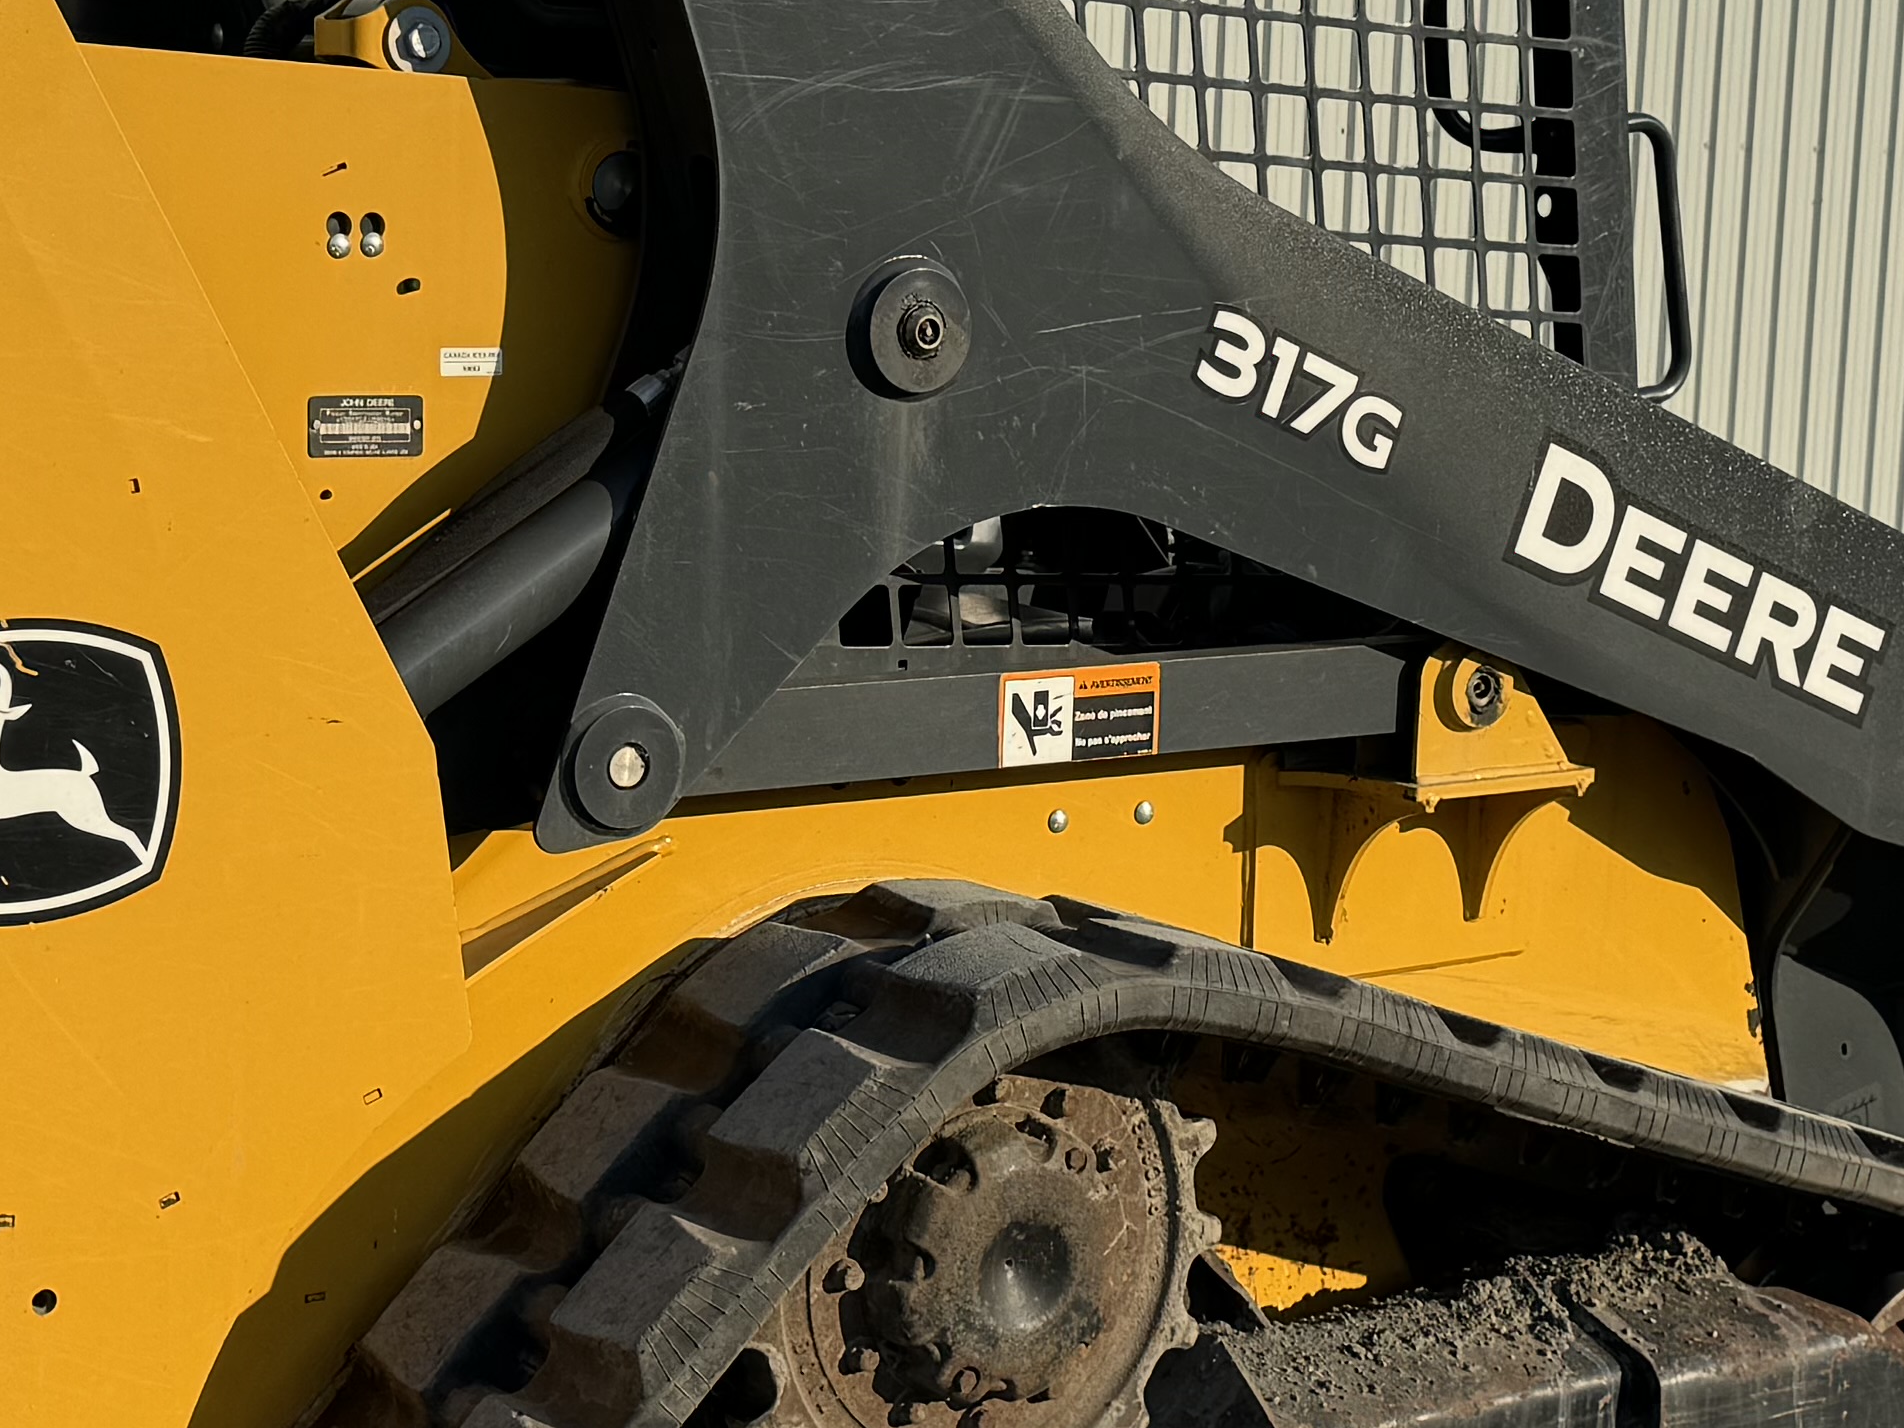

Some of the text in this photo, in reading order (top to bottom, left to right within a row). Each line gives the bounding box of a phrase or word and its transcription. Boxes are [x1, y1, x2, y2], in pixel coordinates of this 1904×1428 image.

[1195, 308, 1404, 471] 317G
[340, 398, 394, 407] JOHN DEERE
[1513, 442, 1885, 715] DEERE
[1075, 705, 1152, 721] Zone de pincement
[1075, 732, 1151, 747] Ne pas s'approcher
